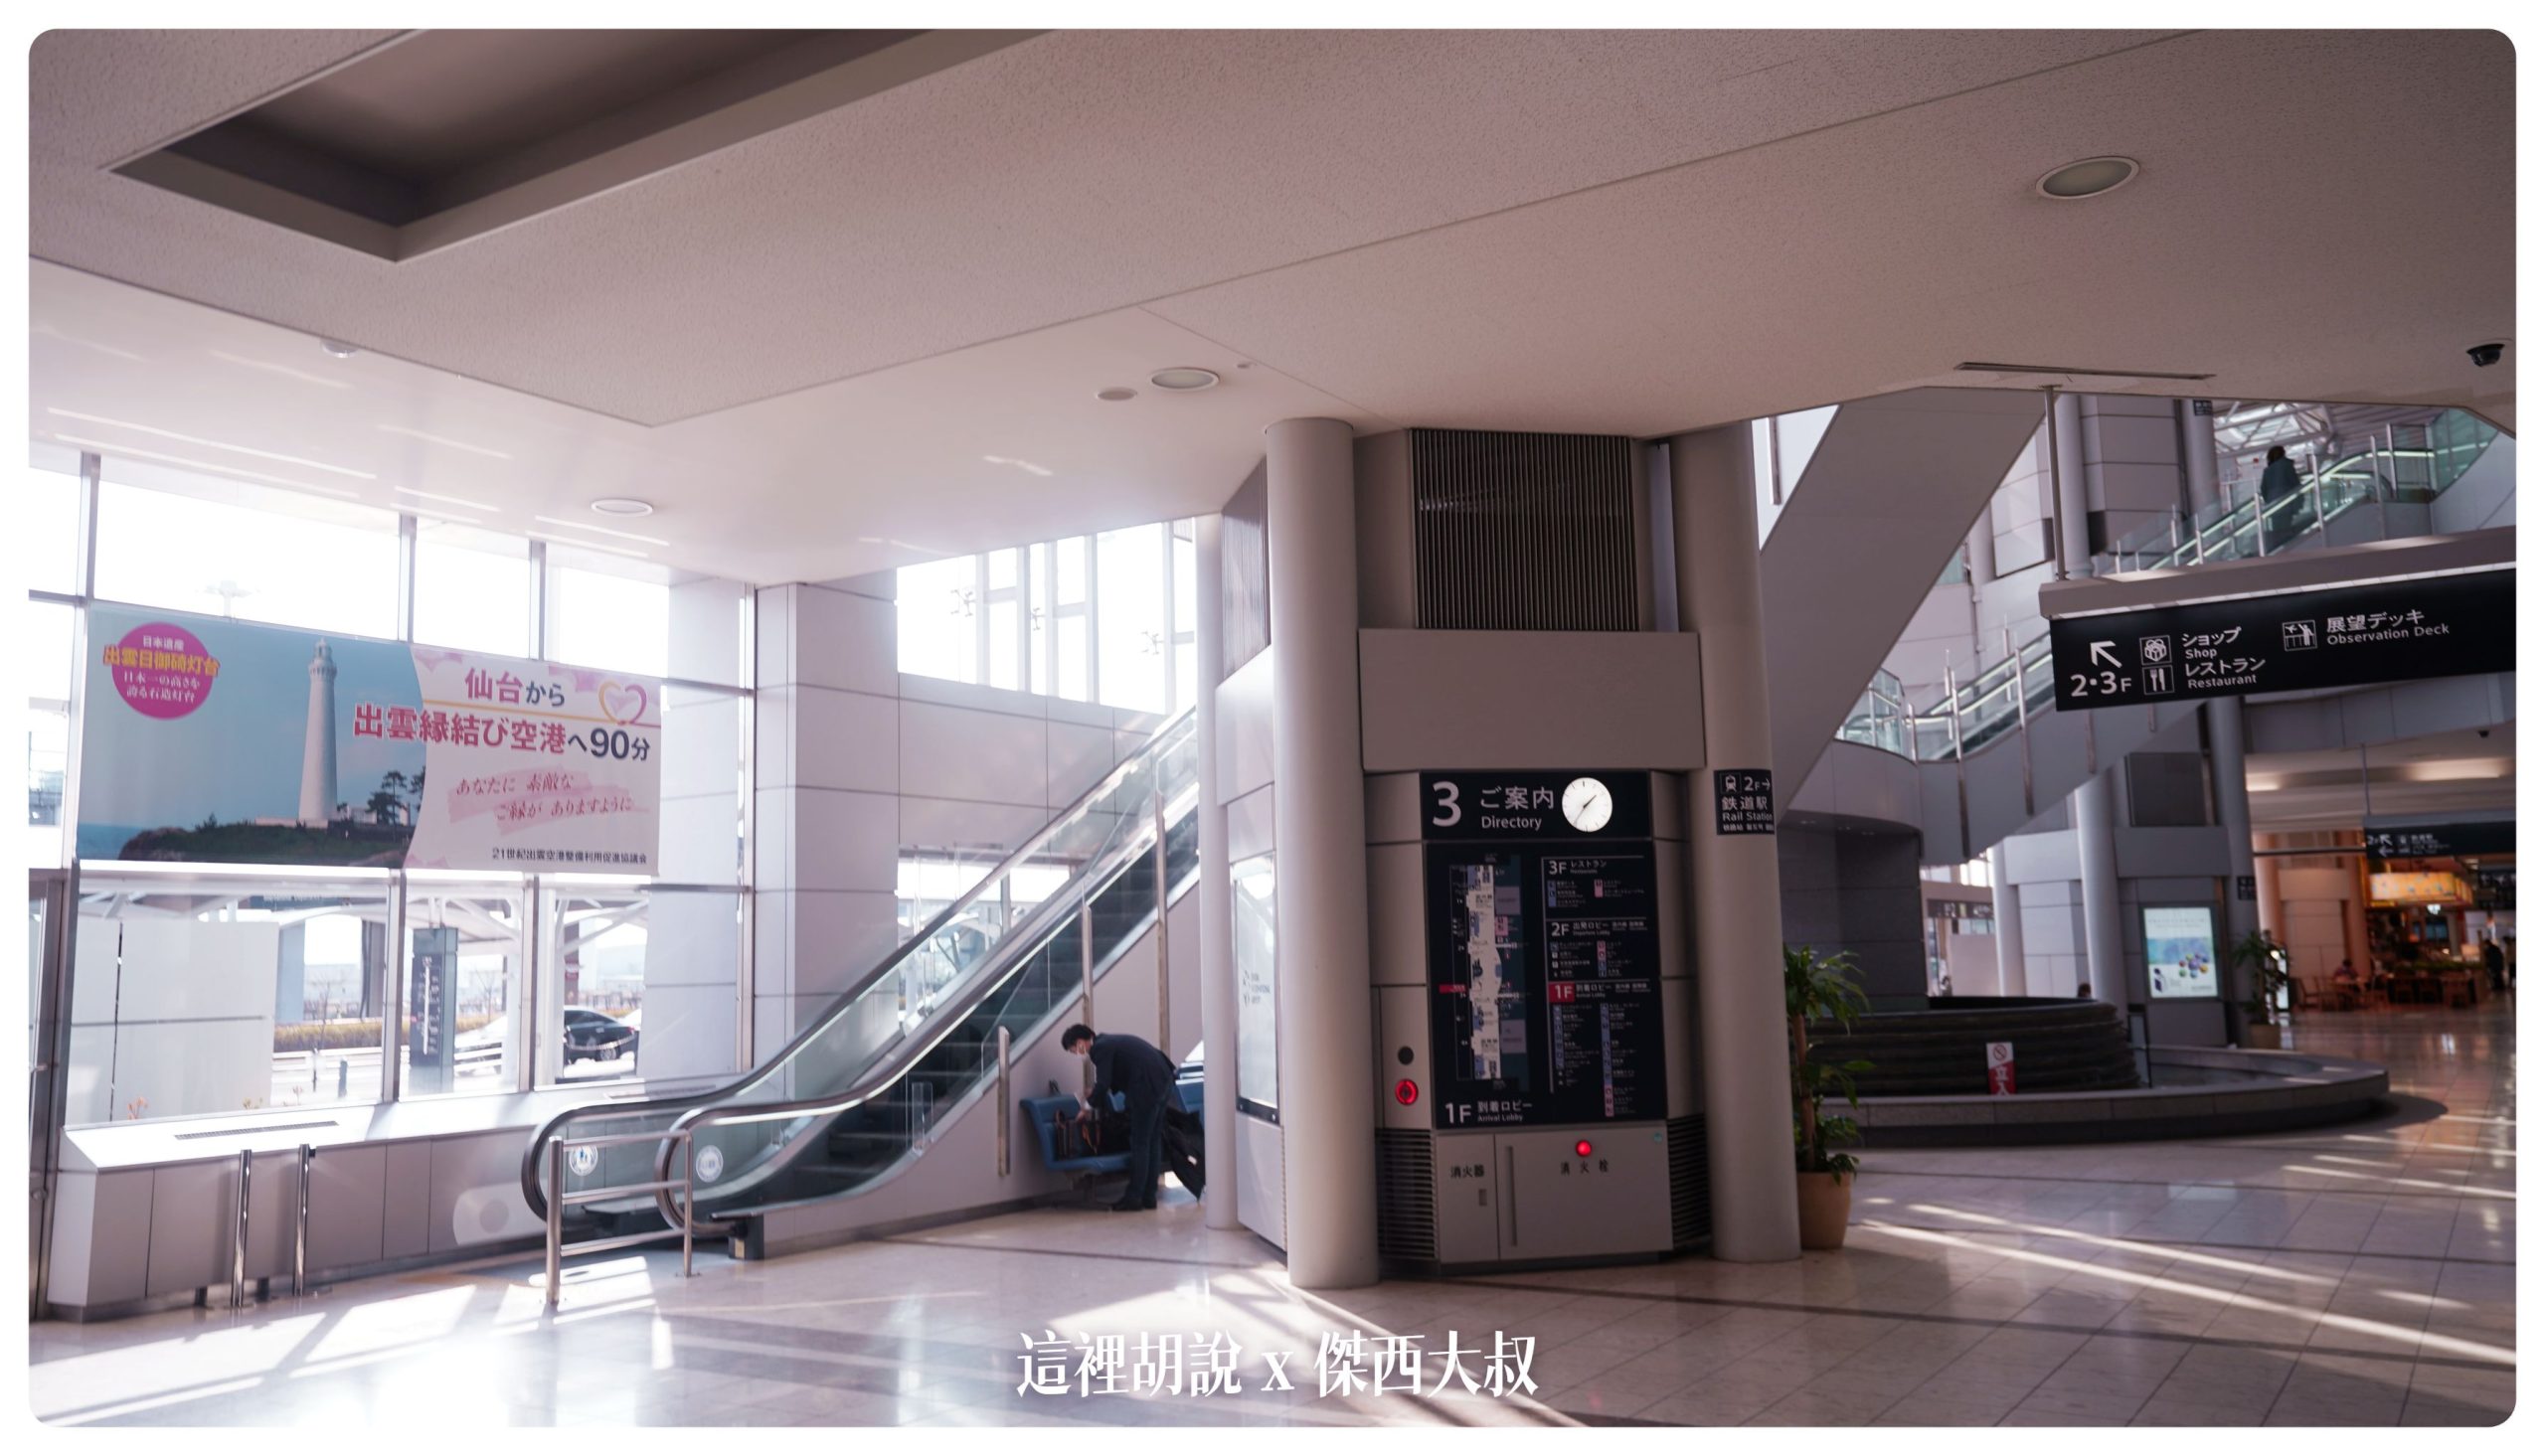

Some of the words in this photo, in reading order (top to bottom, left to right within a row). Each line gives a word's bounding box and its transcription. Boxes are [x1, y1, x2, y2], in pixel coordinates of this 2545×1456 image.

[2326, 609, 2425, 633] 展望デッキ
[2182, 626, 2242, 647] ショップ
[2327, 627, 2410, 645] Observation
[2414, 623, 2451, 637] Deck
[2185, 648, 2218, 660] Shop
[2185, 658, 2266, 677] レストラン
[464, 667, 566, 708] 仙台から
[2187, 675, 2258, 689] Restaurant
[456, 777, 516, 795] あなたに
[527, 771, 575, 791] 素敵な
[1744, 775, 1760, 791] 2F
[1432, 780, 1461, 827] 3
[1480, 786, 1555, 810] ご案内
[1722, 796, 1769, 811] 鉄道駅
[497, 801, 543, 821] ご縁が
[551, 796, 633, 816] ありますように
[1481, 815, 1542, 832] Directory
[1722, 812, 1743, 822] Rail
[1549, 861, 1567, 875] 3F
[1551, 922, 1570, 936] 2F
[1554, 984, 1574, 999] 1F
[1445, 1102, 1472, 1124] 1F
[1477, 1100, 1533, 1113] 到着ロビー
[1502, 1112, 1523, 1121] Lobby
[1450, 1164, 1485, 1179] 消火器
